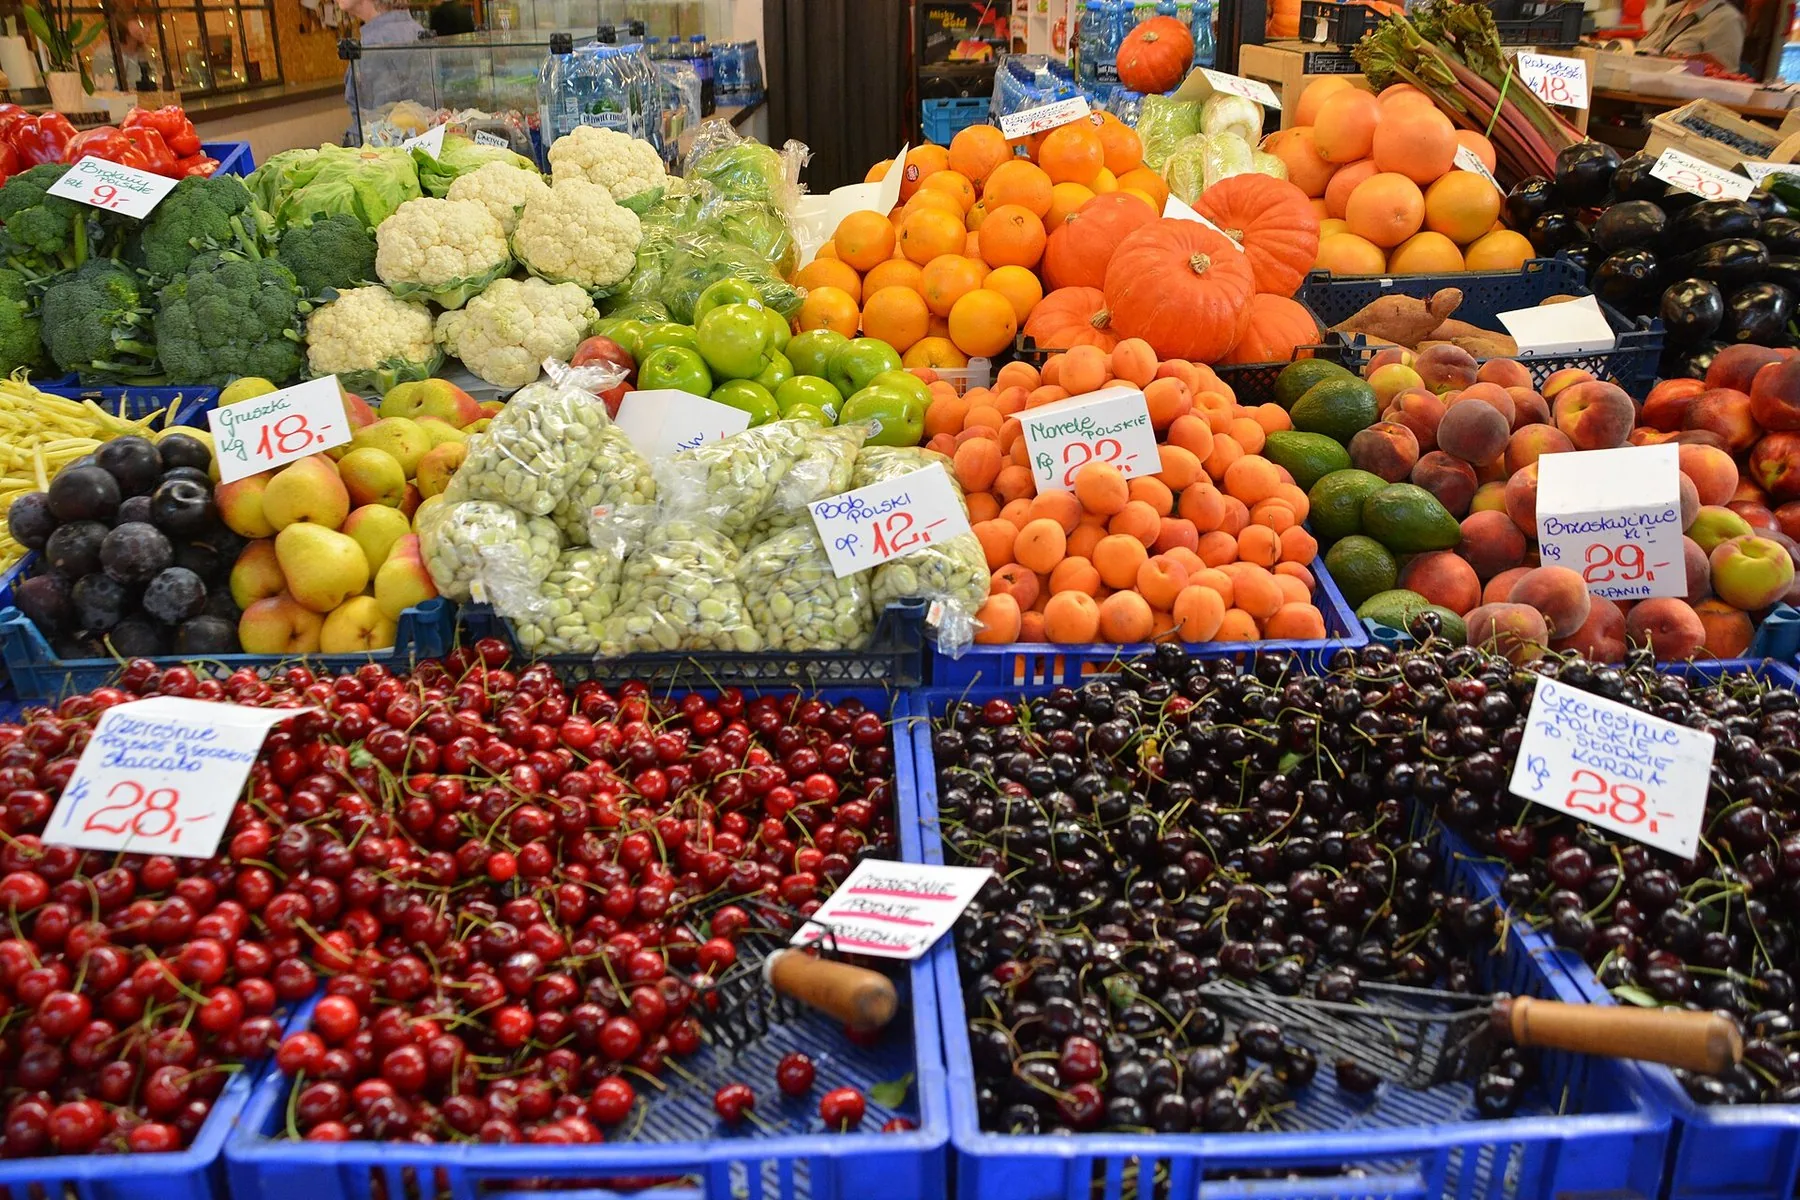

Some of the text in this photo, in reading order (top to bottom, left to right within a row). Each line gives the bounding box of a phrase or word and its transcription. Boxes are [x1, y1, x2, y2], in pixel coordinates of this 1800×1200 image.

[942, 16, 968, 29] Gold
[1540, 75, 1580, 104] 18,-
[220, 394, 291, 437] Gruszki
[1031, 414, 1147, 442] Morele POLSKIE
[815, 493, 911, 523] Bób POLSKI
[1544, 502, 1677, 535] Brzoskwinie
[104, 713, 219, 741] Czereśnie
[1540, 684, 1680, 746] Czereśnie
[1544, 707, 1652, 752] POLSKIE
[1571, 748, 1667, 788] KORDIA
